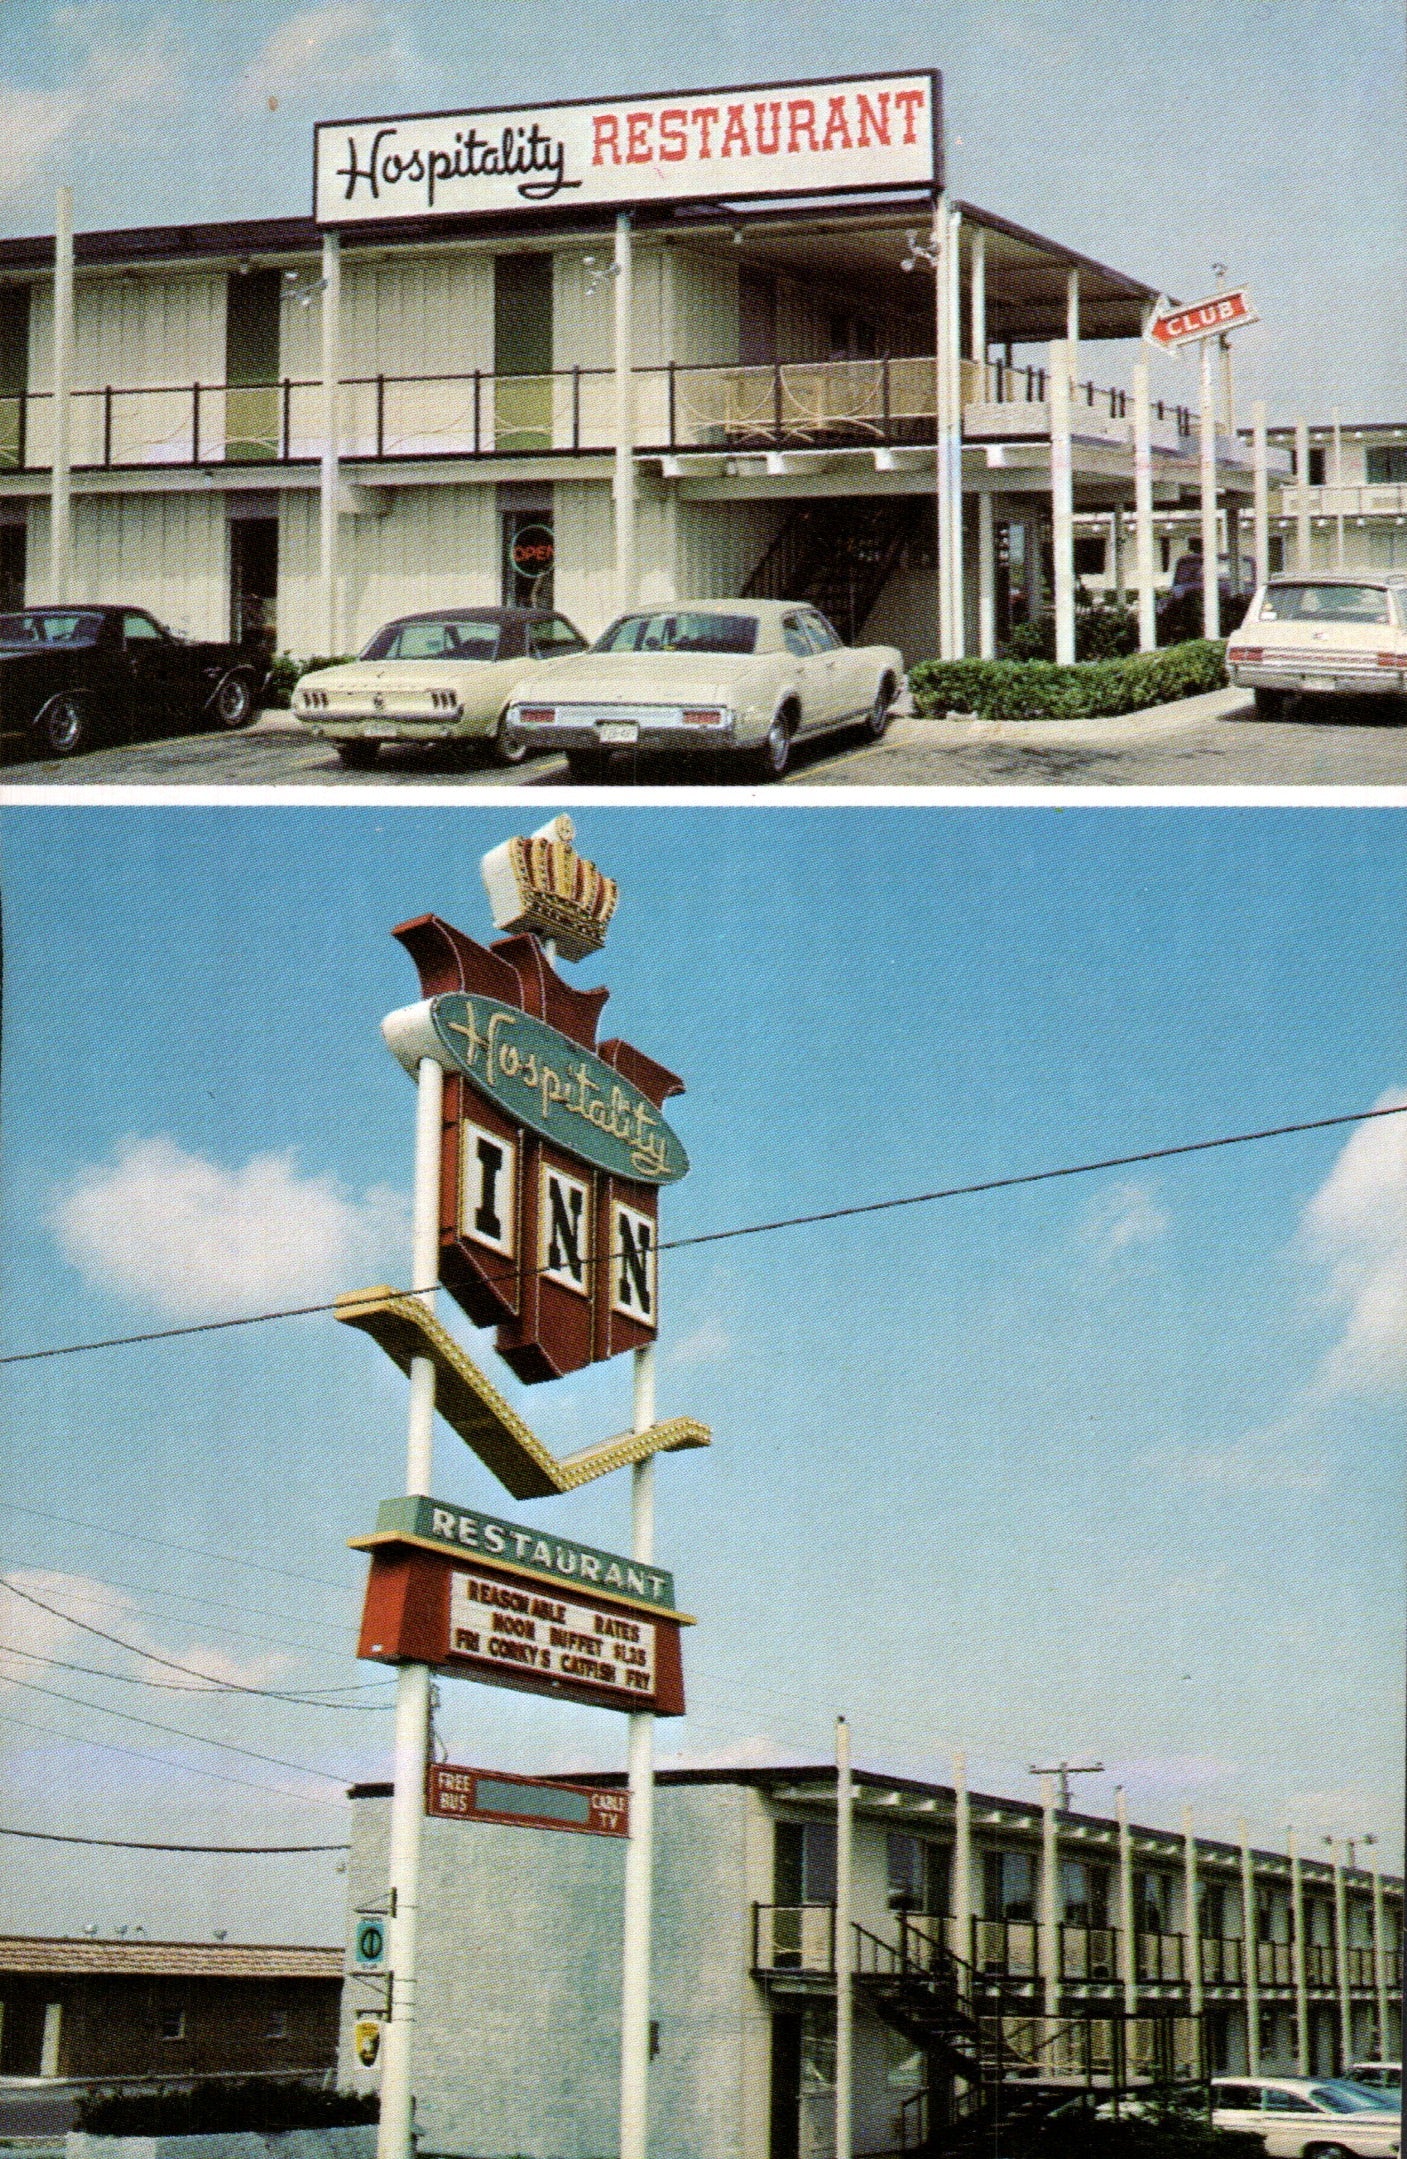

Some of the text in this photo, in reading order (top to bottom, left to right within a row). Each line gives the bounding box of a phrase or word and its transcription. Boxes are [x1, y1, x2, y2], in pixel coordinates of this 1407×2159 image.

[336, 90, 925, 207] Hospitality RESTAURANT
[1166, 301, 1234, 336] CLUB
[448, 1001, 672, 1177] Hospitality
[475, 1136, 651, 1315] INN
[432, 1508, 666, 1600] RESTAURANT
[491, 1611, 536, 1641] NOON
[549, 1626, 604, 1656] BUFFET
[594, 1613, 641, 1643] RATES
[455, 1626, 480, 1653] FRI
[560, 1653, 616, 1684] CATFISH
[624, 1667, 650, 1691] FRY
[438, 1771, 471, 1793] FREE
[439, 1791, 468, 1812] BUS
[600, 1811, 619, 1829] TV
